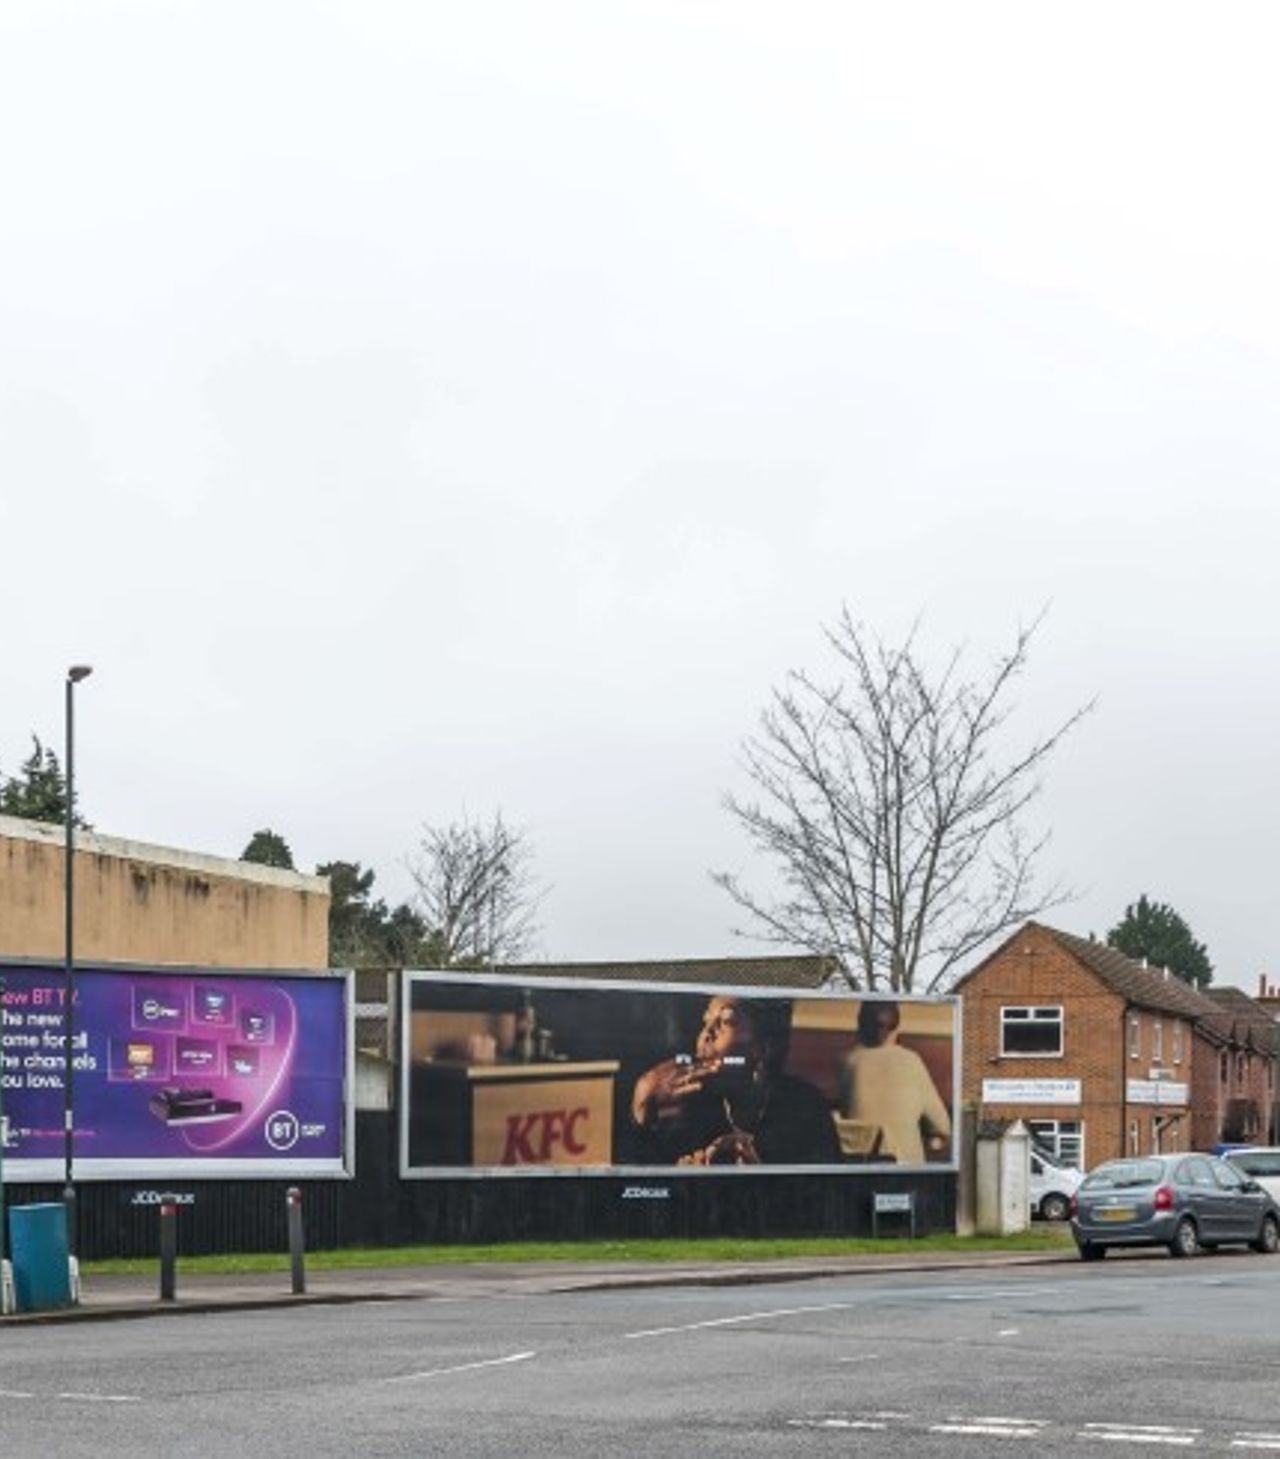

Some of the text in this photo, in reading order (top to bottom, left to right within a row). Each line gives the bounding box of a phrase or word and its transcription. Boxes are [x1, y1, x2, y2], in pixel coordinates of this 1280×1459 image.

[2, 991, 30, 1005] ew
[32, 988, 53, 1005] BT
[1, 1009, 64, 1027] he new
[1, 1034, 40, 1048] ome
[42, 1030, 67, 1049] for
[0, 1051, 98, 1071] he chanels
[273, 1121, 293, 1139] BT
[500, 1106, 590, 1167] KFC
